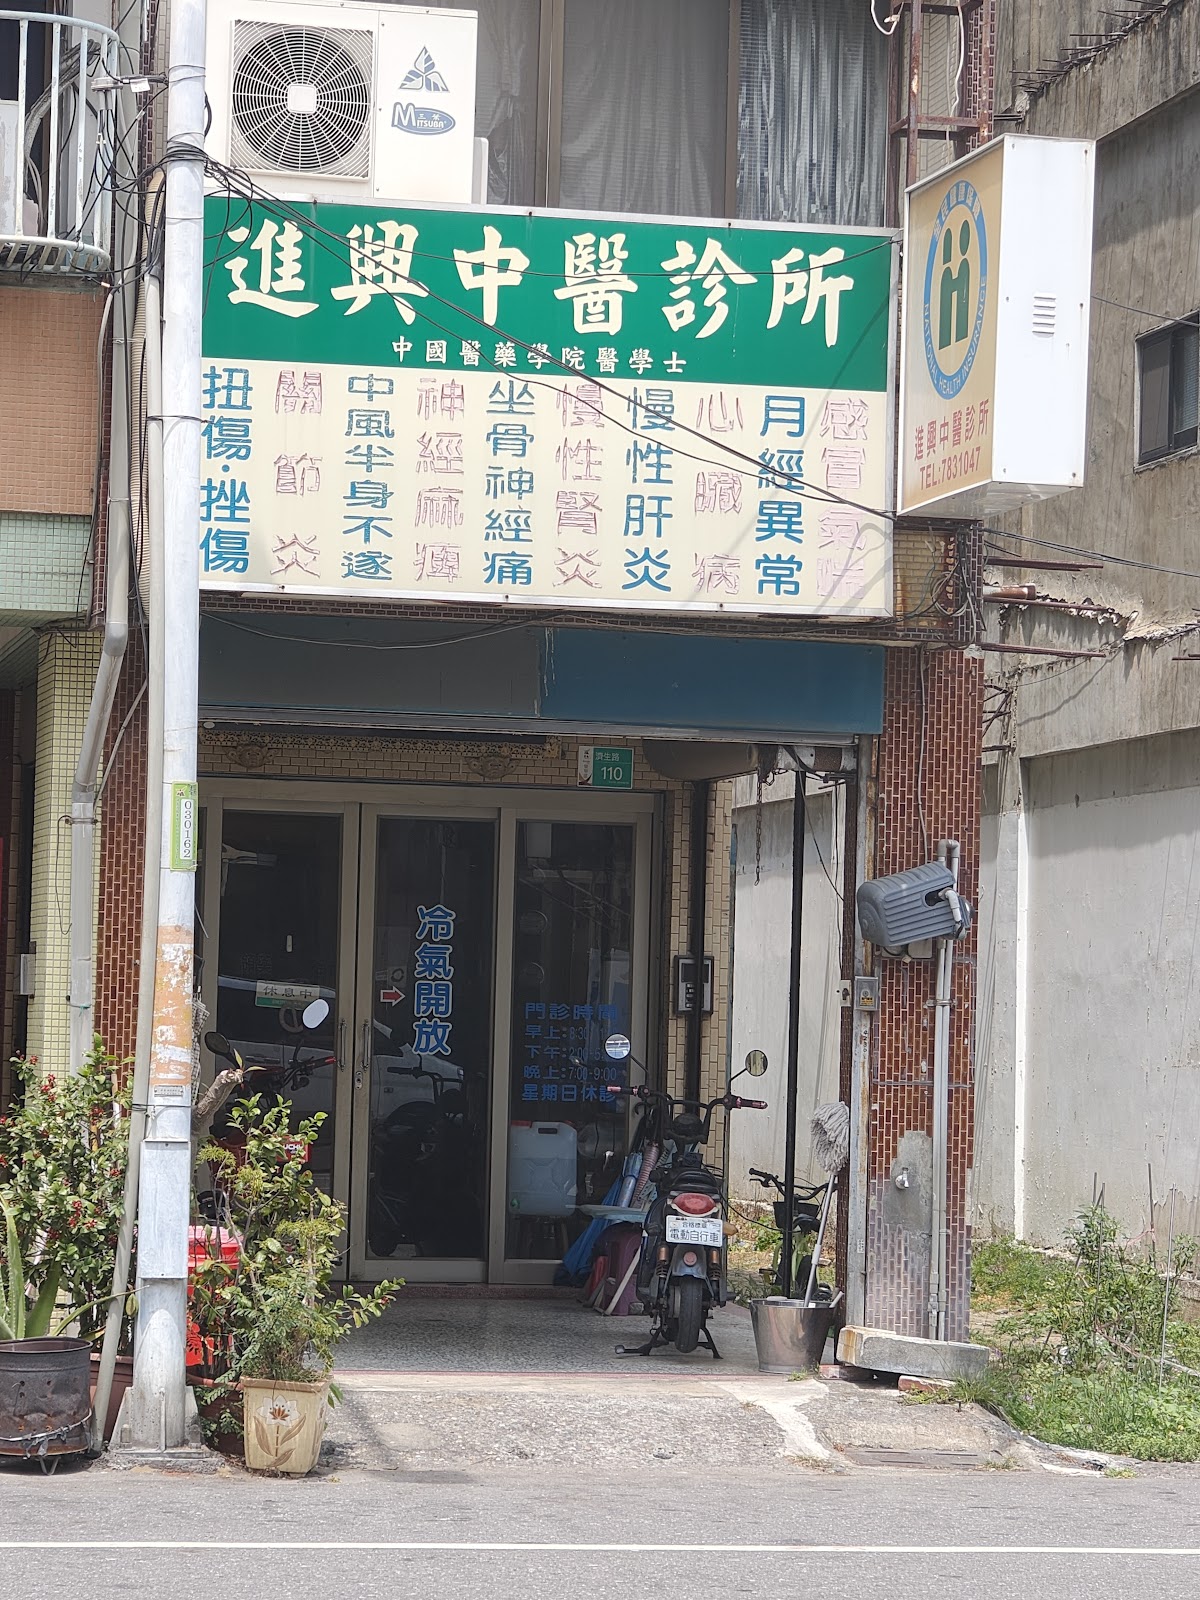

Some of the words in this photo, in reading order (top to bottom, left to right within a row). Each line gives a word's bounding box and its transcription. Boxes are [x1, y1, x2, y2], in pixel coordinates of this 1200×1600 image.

[225, 218, 854, 348] 進興中醫診所
[391, 335, 687, 375] 中國醫藥學院醫學士
[914, 399, 989, 461] 進興中醫診所
[341, 373, 395, 581] 中風半身不遂
[483, 379, 536, 586] 坐骨神經痛
[621, 386, 676, 592] 慢性肝炎
[755, 395, 806, 596] 月經異常
[920, 446, 981, 490] TEL:7831047
[601, 767, 623, 781] 110
[183, 801, 191, 858] 030162
[263, 985, 312, 999] 休息中
[412, 904, 457, 1056] 冷氣開放
[525, 1002, 617, 1020] 門診時間
[522, 1083, 616, 1102] 星期日休診
[670, 1229, 719, 1243] 電動自行車
